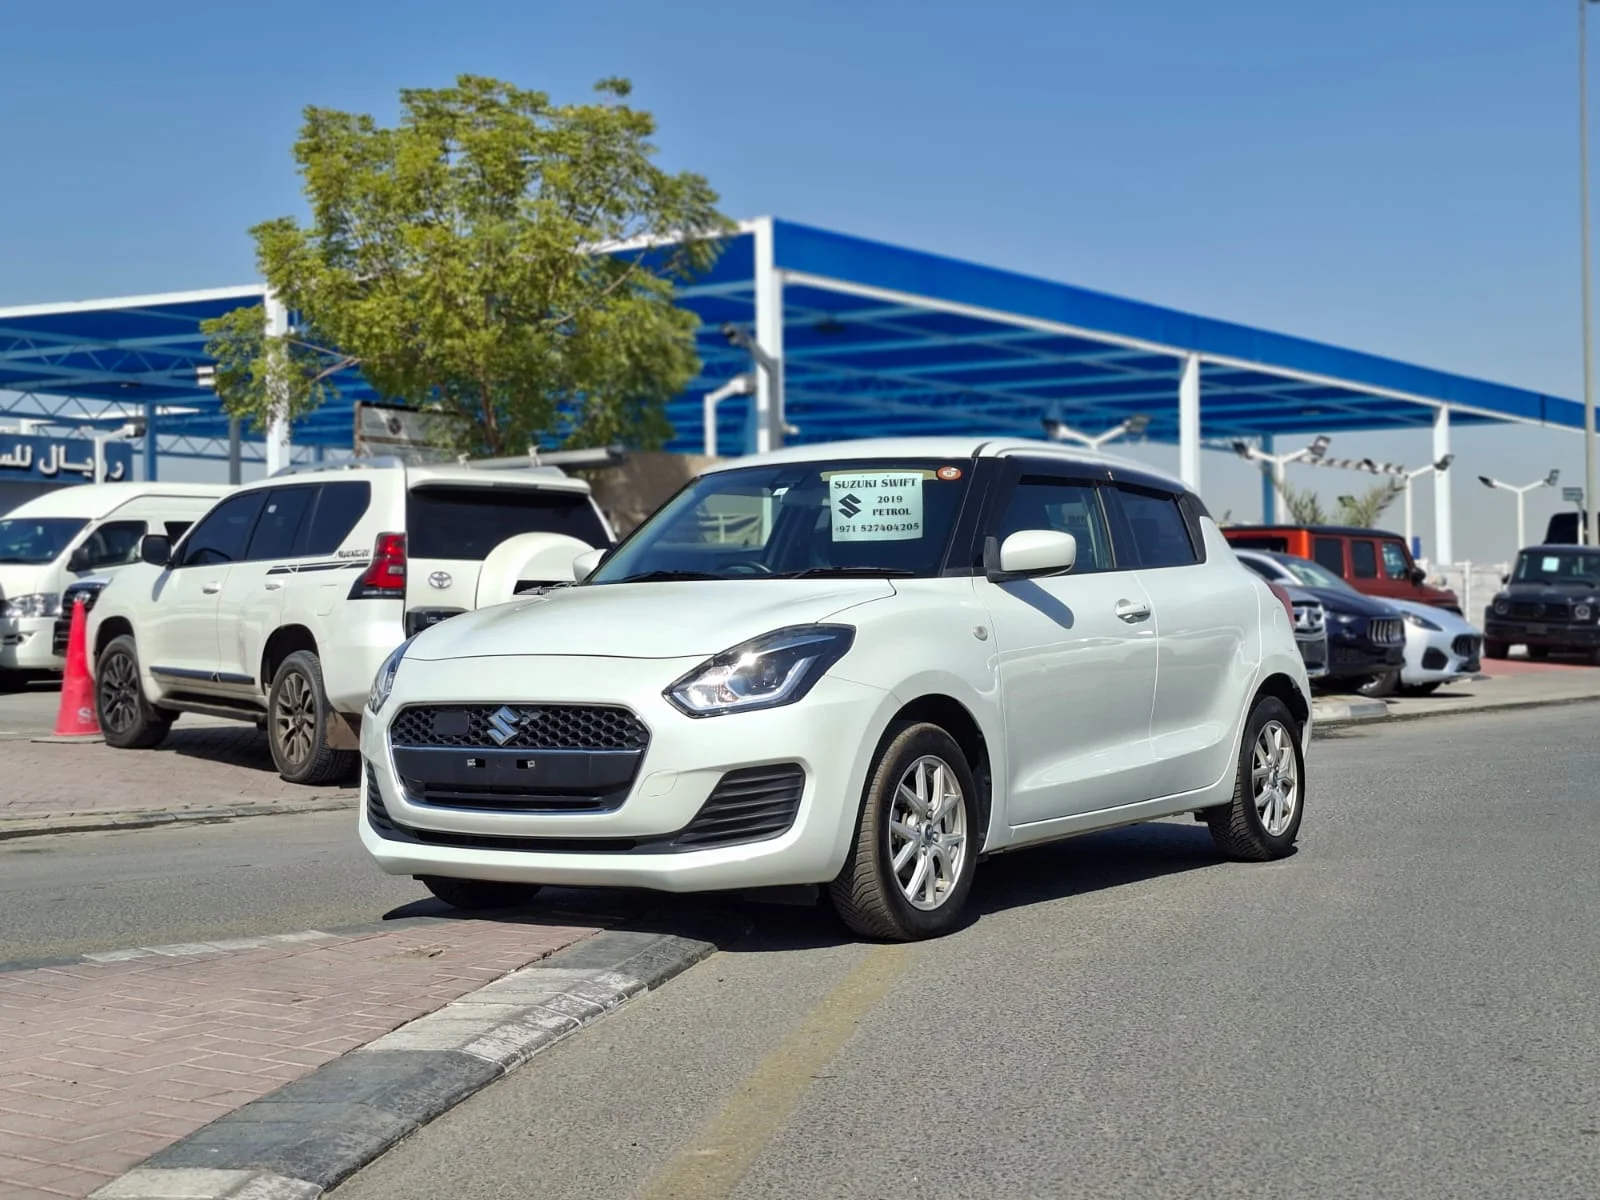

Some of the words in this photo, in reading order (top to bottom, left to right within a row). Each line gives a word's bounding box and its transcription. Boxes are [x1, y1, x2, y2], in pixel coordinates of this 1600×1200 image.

[834, 480, 877, 489] SUZUKI
[881, 478, 917, 487] SWIFT
[872, 508, 912, 516] PETROL
